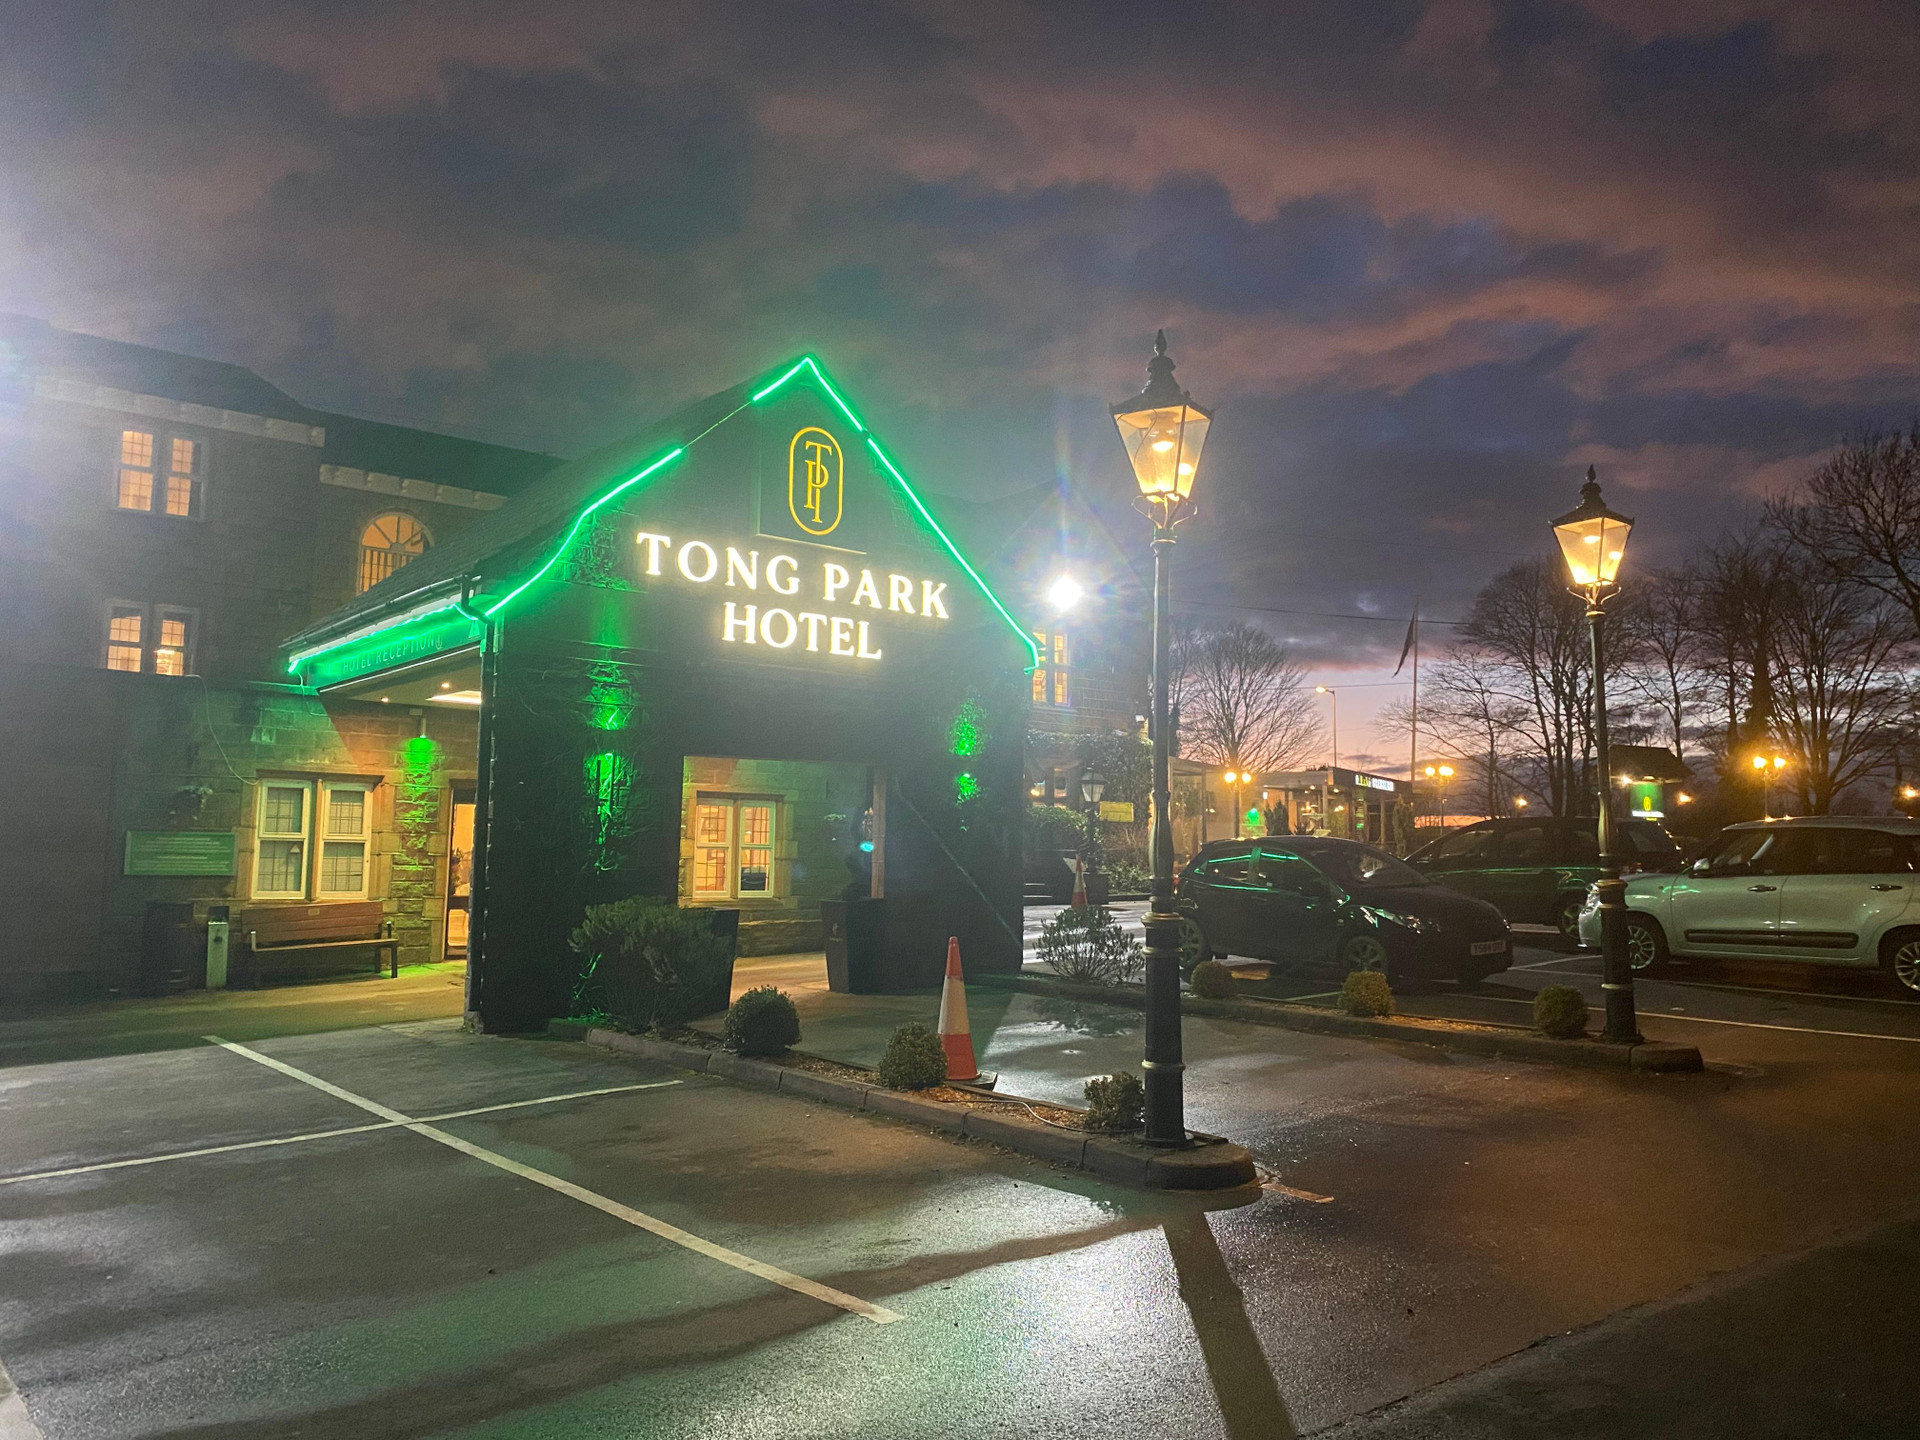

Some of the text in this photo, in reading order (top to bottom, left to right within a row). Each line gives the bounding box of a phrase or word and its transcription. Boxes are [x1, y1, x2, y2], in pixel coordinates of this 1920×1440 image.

[636, 531, 950, 620] TONG PARK
[343, 654, 371, 673] HOTEL
[376, 633, 434, 662] RECEPTION
[722, 601, 883, 660] HOTEL
